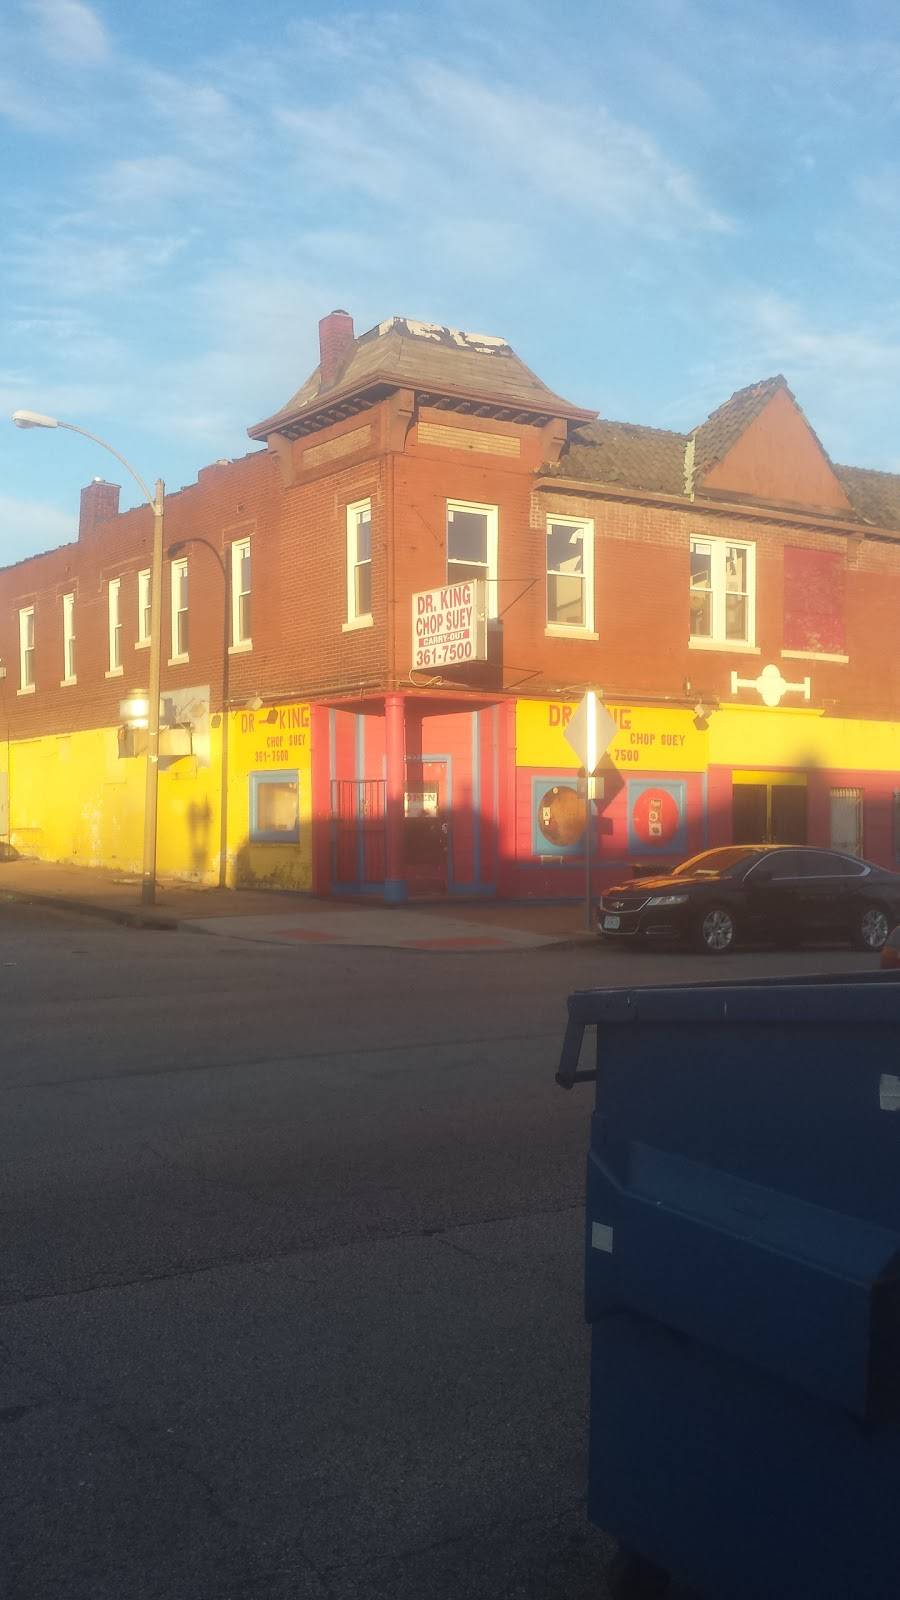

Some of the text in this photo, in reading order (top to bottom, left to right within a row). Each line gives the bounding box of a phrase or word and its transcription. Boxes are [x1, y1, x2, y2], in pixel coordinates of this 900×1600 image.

[417, 585, 470, 615] DR. KING
[416, 606, 472, 637] CHOP SUEY
[423, 630, 465, 646] CARRY-OUT
[280, 707, 309, 729] KING
[267, 734, 305, 748] CHOP SUEY
[630, 733, 685, 746] CHOP SUEY
[615, 748, 639, 762] 7500
